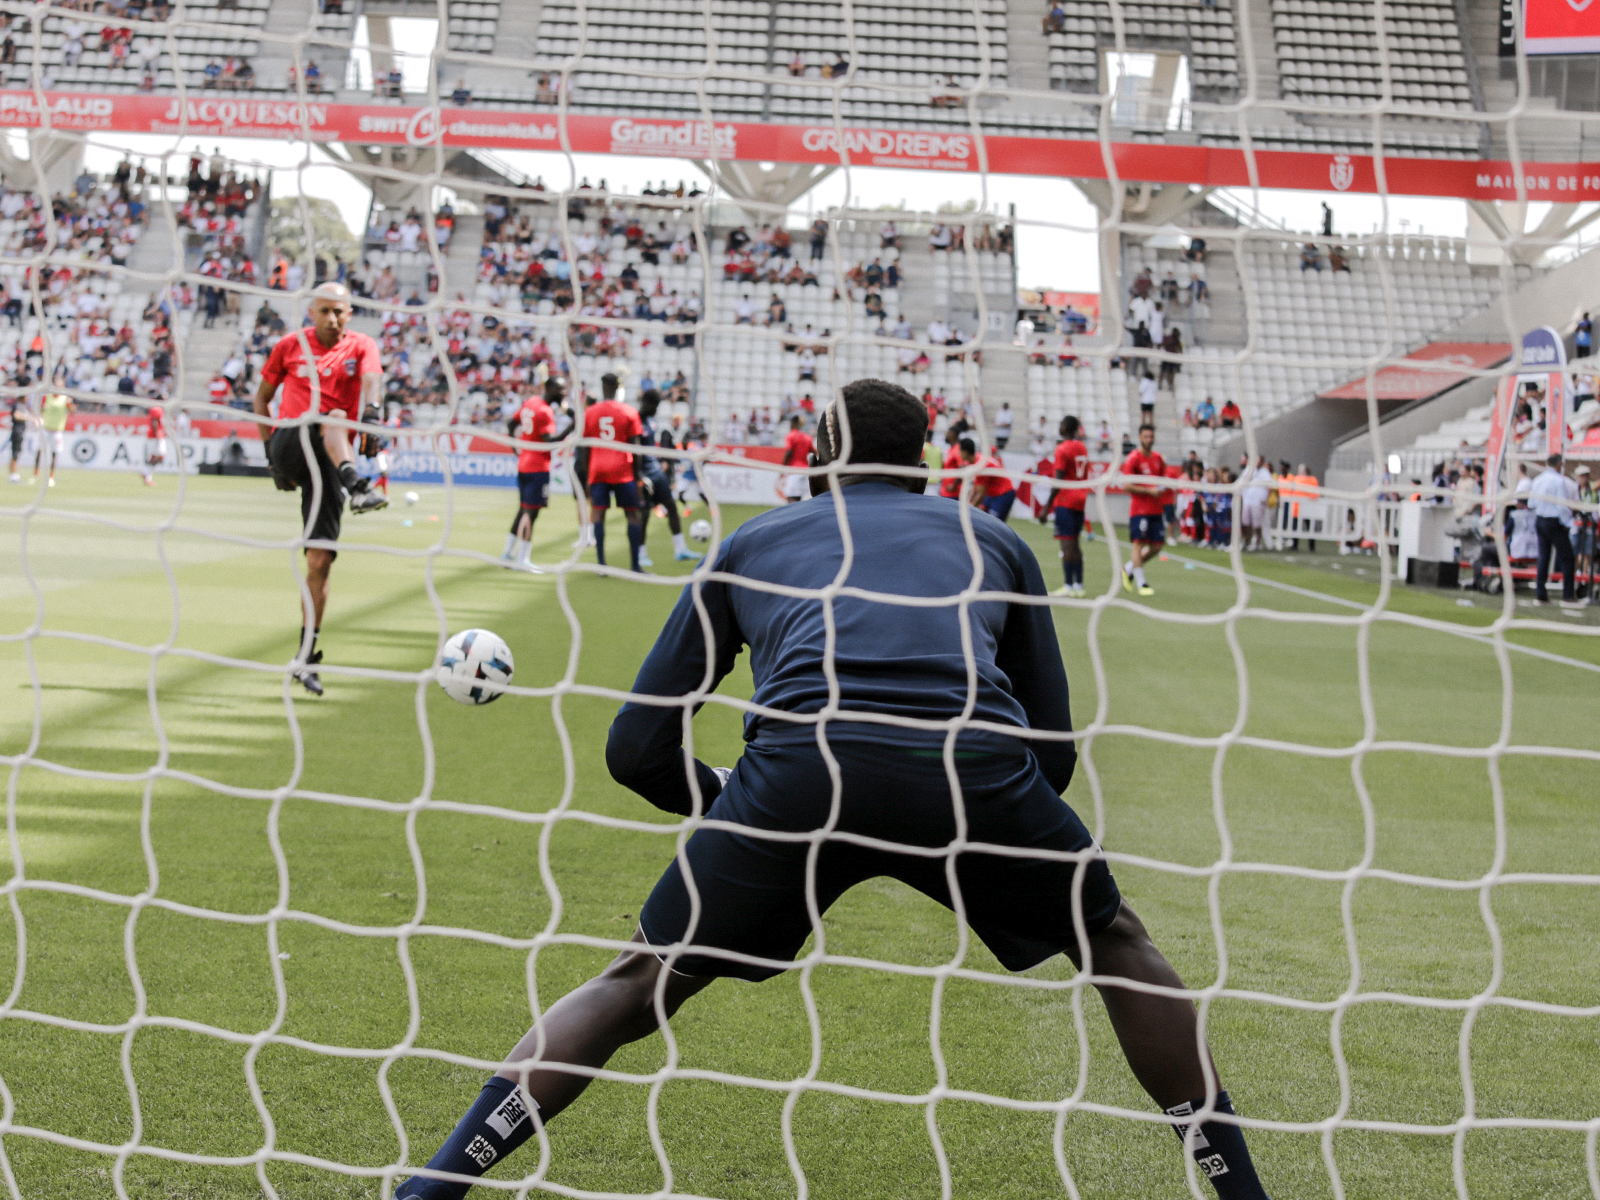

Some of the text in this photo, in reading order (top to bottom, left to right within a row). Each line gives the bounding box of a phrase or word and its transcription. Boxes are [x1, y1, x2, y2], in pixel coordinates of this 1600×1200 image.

[0, 111, 112, 128] MATRIAUX
[165, 99, 328, 127] JACQUESON
[1476, 173, 1550, 191] MAION
[1556, 175, 1578, 191] DE
[598, 416, 616, 441] 5
[379, 452, 519, 478] ONSTUCTION
